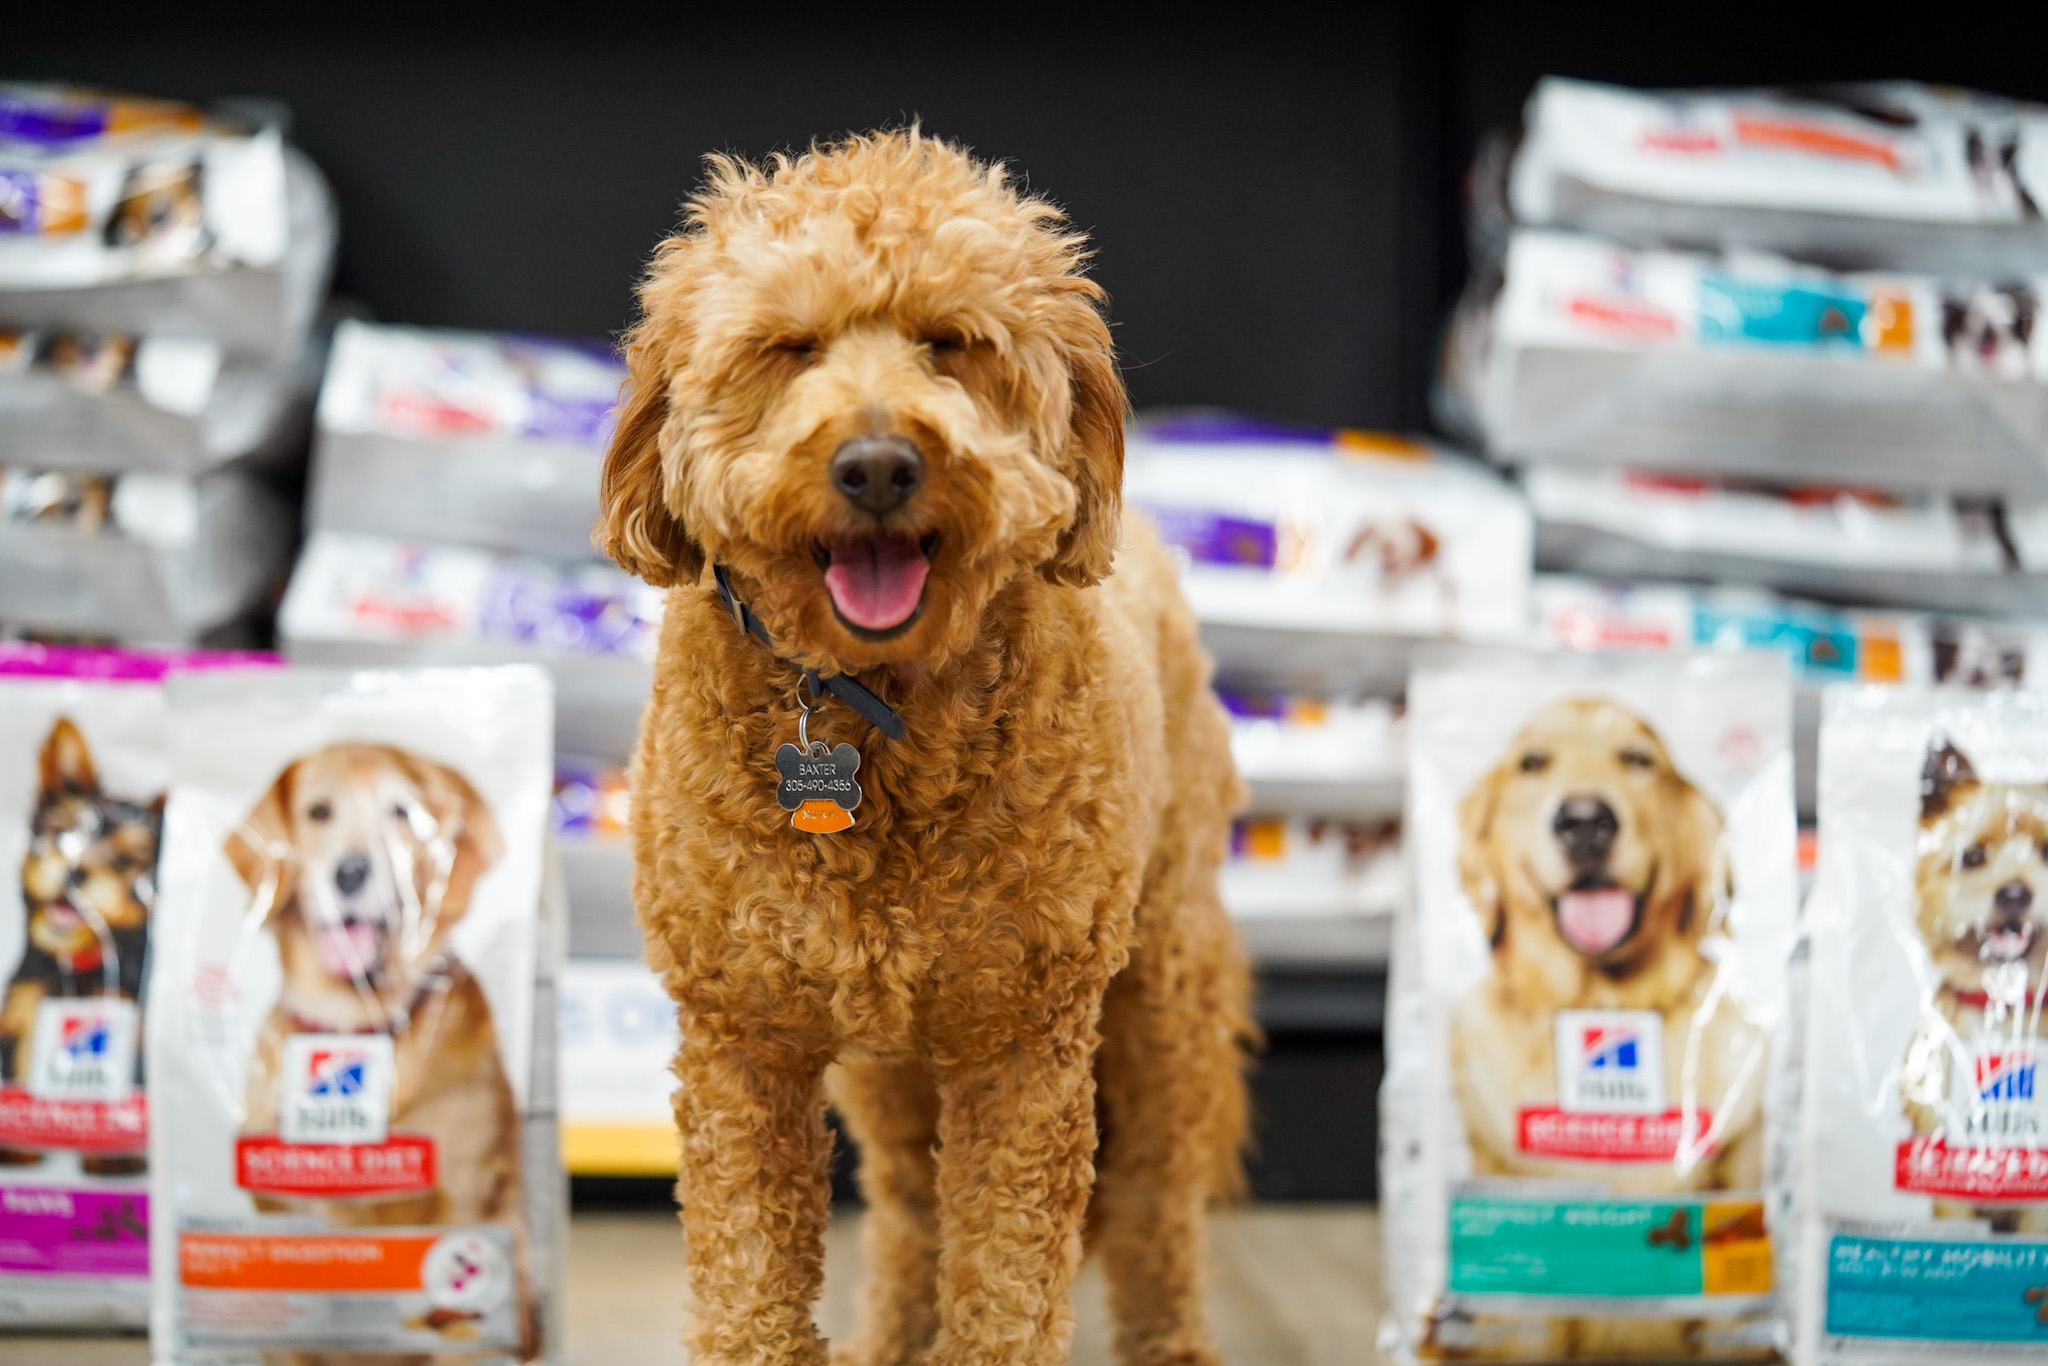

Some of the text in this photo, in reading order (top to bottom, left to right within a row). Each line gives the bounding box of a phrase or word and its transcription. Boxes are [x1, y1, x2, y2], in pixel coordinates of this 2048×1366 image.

[799, 764, 835, 775] BAXTER
[785, 780, 851, 791] 305-490-4356
[1526, 1116, 1636, 1139] SCIENCE
[245, 1147, 353, 1170] SCIENCE
